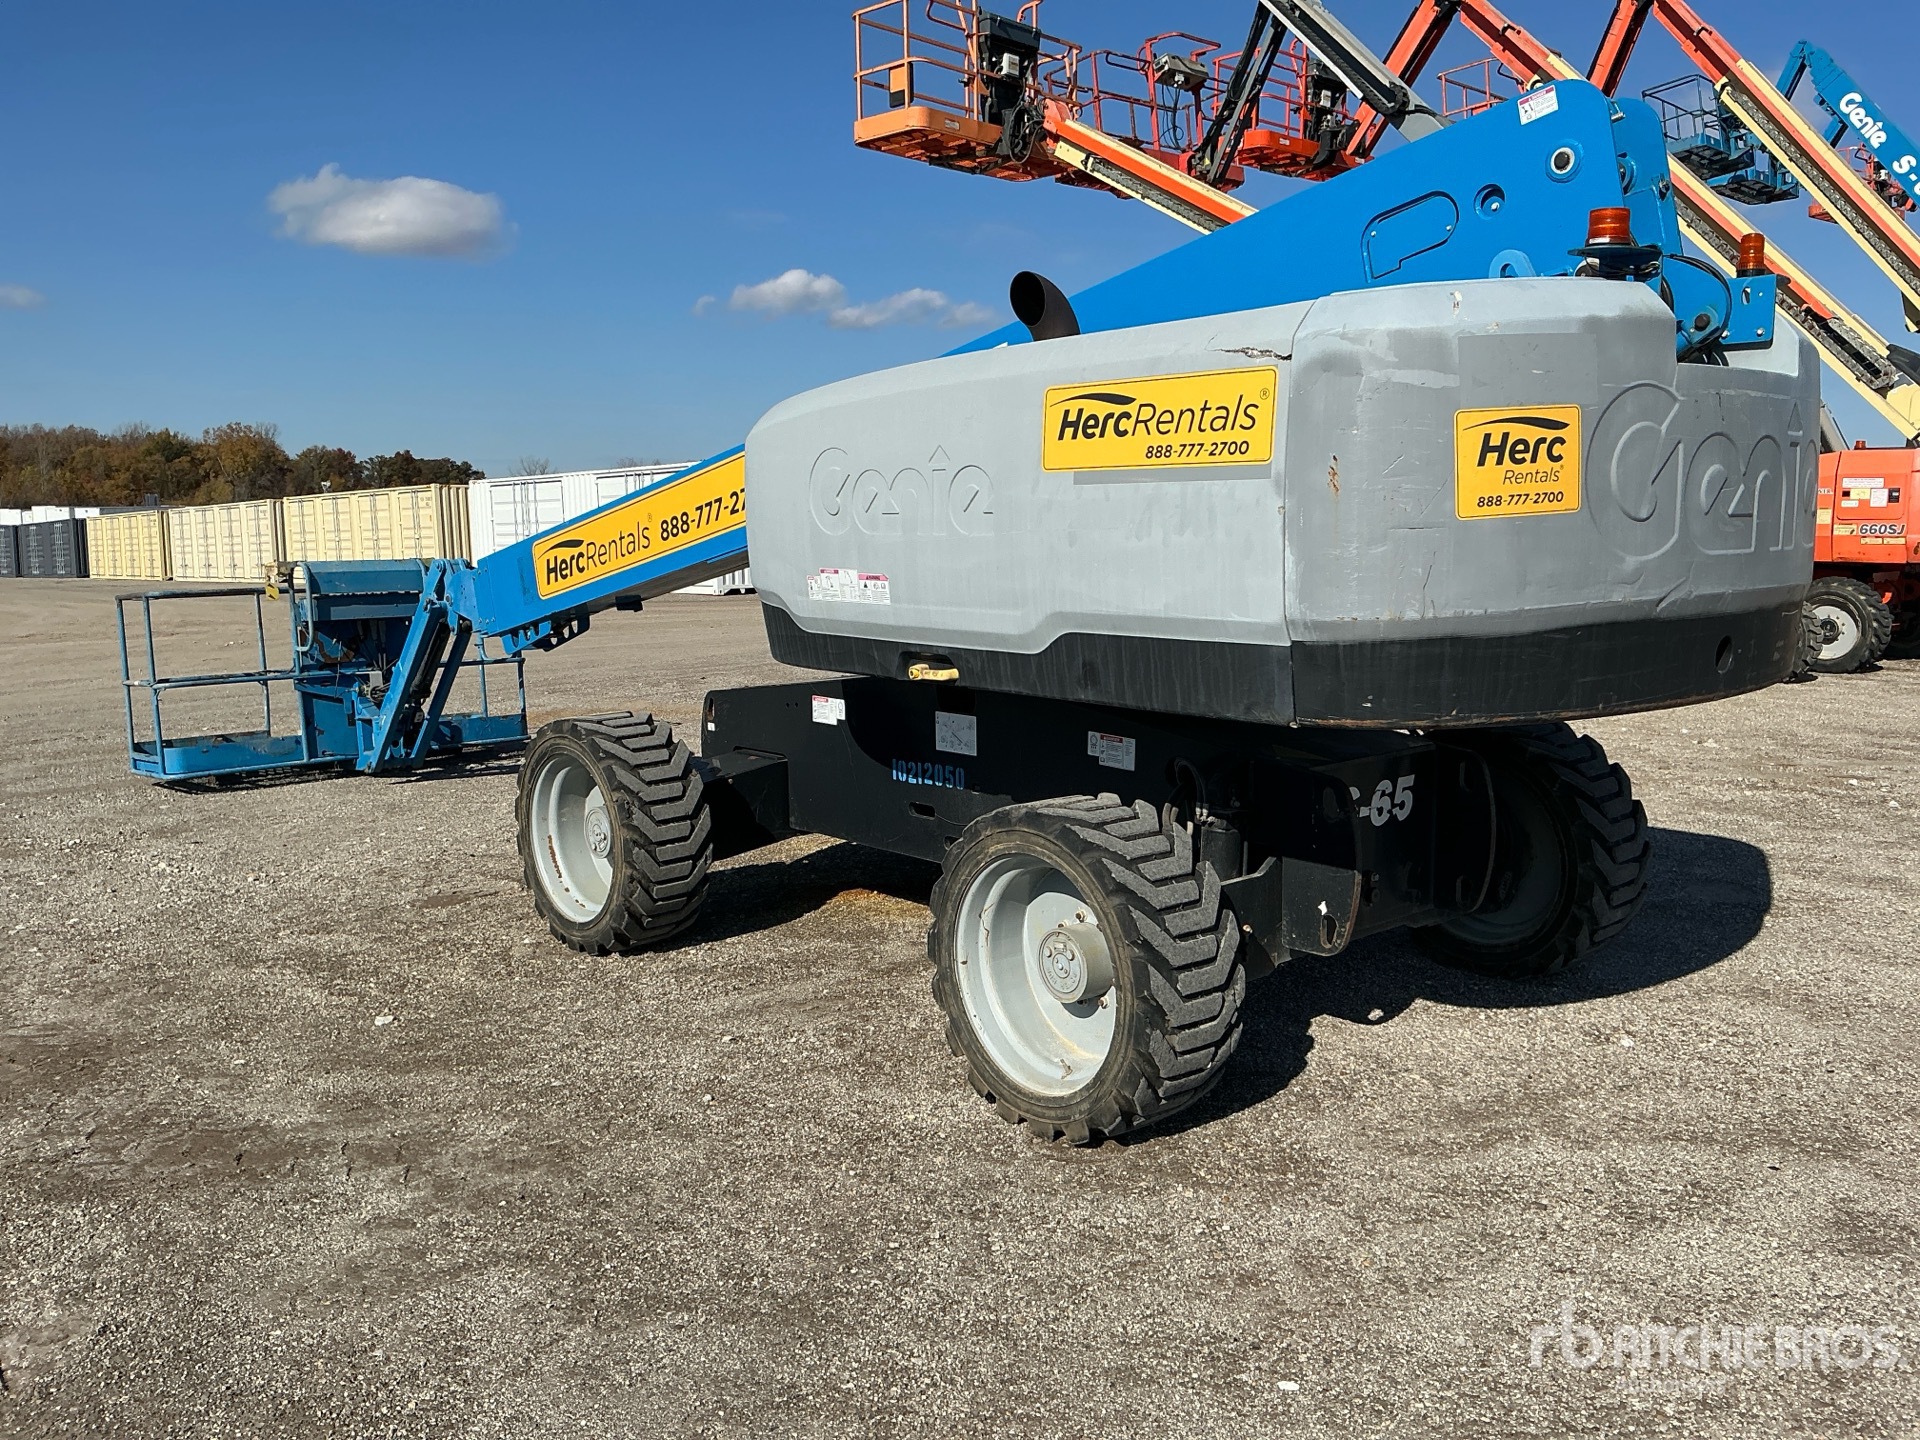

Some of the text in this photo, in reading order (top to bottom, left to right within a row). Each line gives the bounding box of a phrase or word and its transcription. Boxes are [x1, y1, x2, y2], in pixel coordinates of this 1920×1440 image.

[1840, 92, 1887, 149] Genie
[1145, 440, 1249, 459] 888-777-2700
[1477, 432, 1566, 467] Herc
[1503, 467, 1560, 485] Rentals
[809, 445, 995, 536] Genie
[1477, 491, 1564, 507] 888-777-2700
[1860, 524, 1905, 535] 660SJ
[892, 759, 965, 790] 10212050
